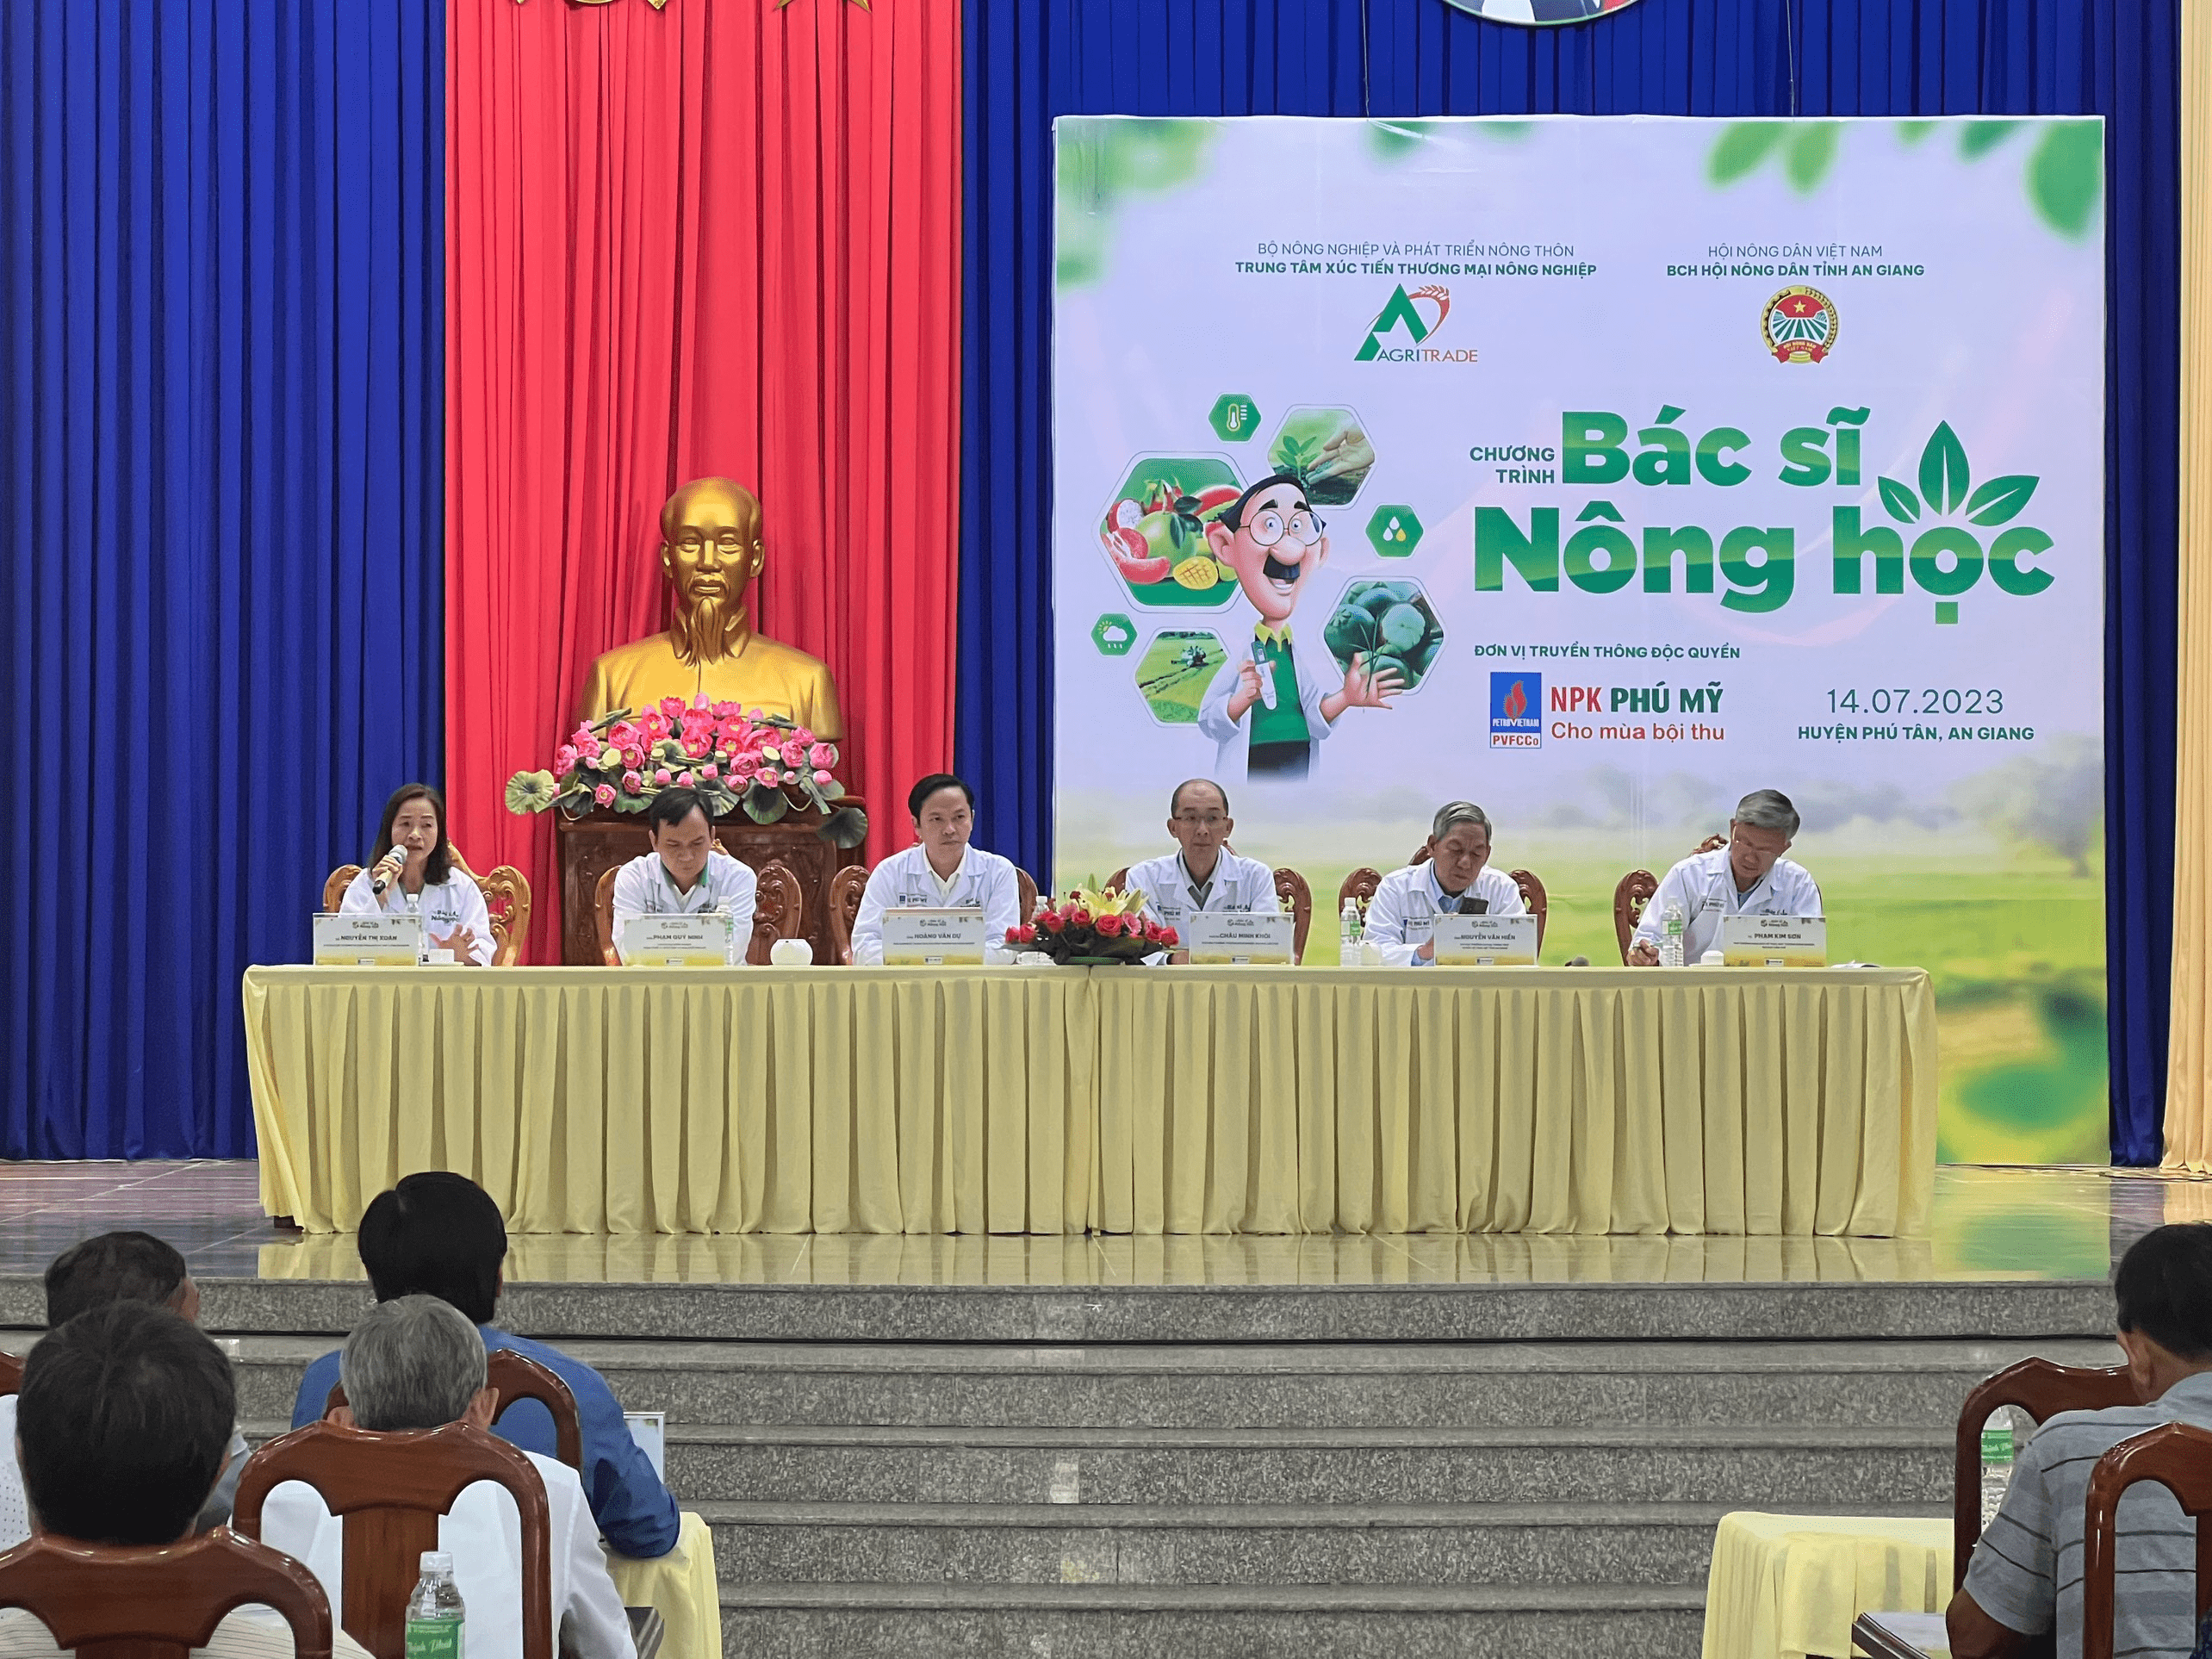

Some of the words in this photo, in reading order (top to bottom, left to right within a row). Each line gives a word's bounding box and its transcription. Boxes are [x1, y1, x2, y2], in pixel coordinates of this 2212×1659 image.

[1258, 240, 1277, 257] BỘ
[1283, 240, 1324, 255] NÔNG
[1328, 241, 1379, 258] NGHIỆP
[1382, 241, 1401, 255] VÀ
[1405, 241, 1440, 255] PHÁT
[1445, 239, 1484, 256] TRIỂN
[1488, 242, 1530, 256] NÔNG
[1534, 243, 1574, 257] THÔN
[1709, 243, 1732, 259] HỘI
[1737, 243, 1779, 257] NÔNG
[1783, 243, 1811, 257] DÂN
[1816, 243, 1847, 259] VIỆT
[1851, 245, 1882, 257] NAM
[1235, 262, 1286, 273] TRUNG
[1290, 260, 1320, 273] TÂM
[1326, 259, 1357, 273] XÚC
[1361, 258, 1393, 274] TIẾN
[1398, 262, 1460, 275] THƯƠNG
[1464, 264, 1491, 278] MẠI
[1496, 262, 1538, 275] NÔNG
[1543, 262, 1596, 279] NGHIỆP
[1668, 265, 1697, 276] BCH
[1702, 262, 1726, 279] HỘI
[1731, 262, 1774, 276] NÔNG
[1779, 262, 1809, 276] DÂN
[1813, 261, 1847, 276] TỈNH
[1852, 265, 1872, 276] AN
[1877, 264, 1924, 276] GIANG
[1376, 349, 1478, 363] AGRITRADE
[1469, 444, 1555, 462] CHƯƠNG
[1563, 405, 1752, 487] Bác
[1779, 407, 1870, 487] sĩ
[1495, 465, 1555, 484] TRÌNH
[1475, 500, 1794, 613] Nông
[1833, 506, 2055, 624] học
[1475, 643, 1507, 656] ĐƠN
[1511, 646, 1525, 660] VỊ
[1530, 641, 1589, 657] TRUYỀN
[1594, 643, 1647, 657] THÔNG
[1651, 644, 1684, 662] ĐỘC
[1688, 643, 1739, 658] QUYỀN
[1551, 687, 1601, 712] NPK
[1611, 681, 1669, 713] PHÚ
[1681, 681, 1723, 712] MỸ
[1828, 689, 2003, 713] 14.07.2023
[1552, 723, 1592, 738] Cho
[1600, 724, 1645, 739] mùa
[1653, 723, 1683, 743] bội
[1692, 724, 1724, 740] thu
[1799, 724, 1857, 743] HUYỆN
[1862, 723, 1897, 739] PHÚ
[1902, 724, 1942, 742] TÂN,
[1948, 727, 1973, 739] AN
[1978, 727, 2034, 740] GIANG
